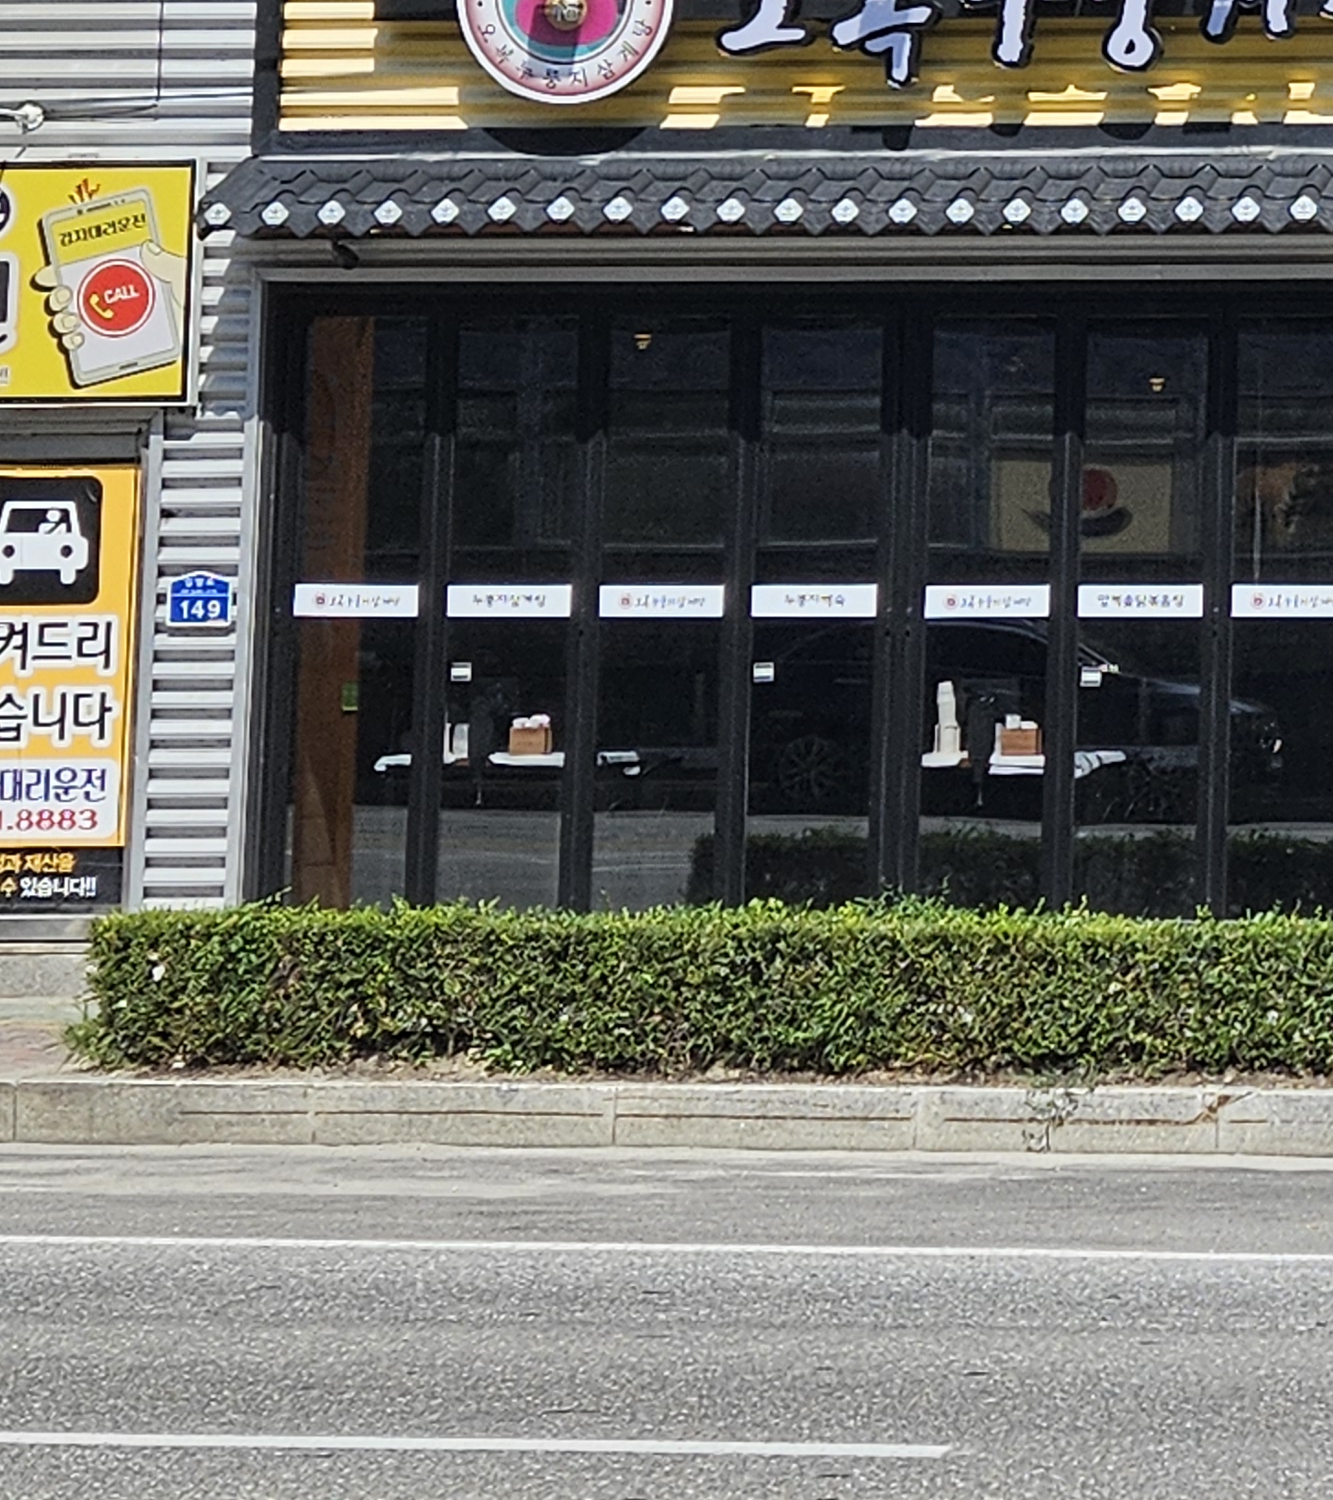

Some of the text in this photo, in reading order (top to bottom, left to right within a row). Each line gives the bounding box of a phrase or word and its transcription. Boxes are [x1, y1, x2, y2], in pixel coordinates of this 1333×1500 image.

[103, 284, 140, 304] CALL
[180, 600, 221, 619] 149
[0, 691, 113, 741] 습니다
[0, 766, 107, 802] 대리운전
[20, 876, 98, 898] 있습니다!!
